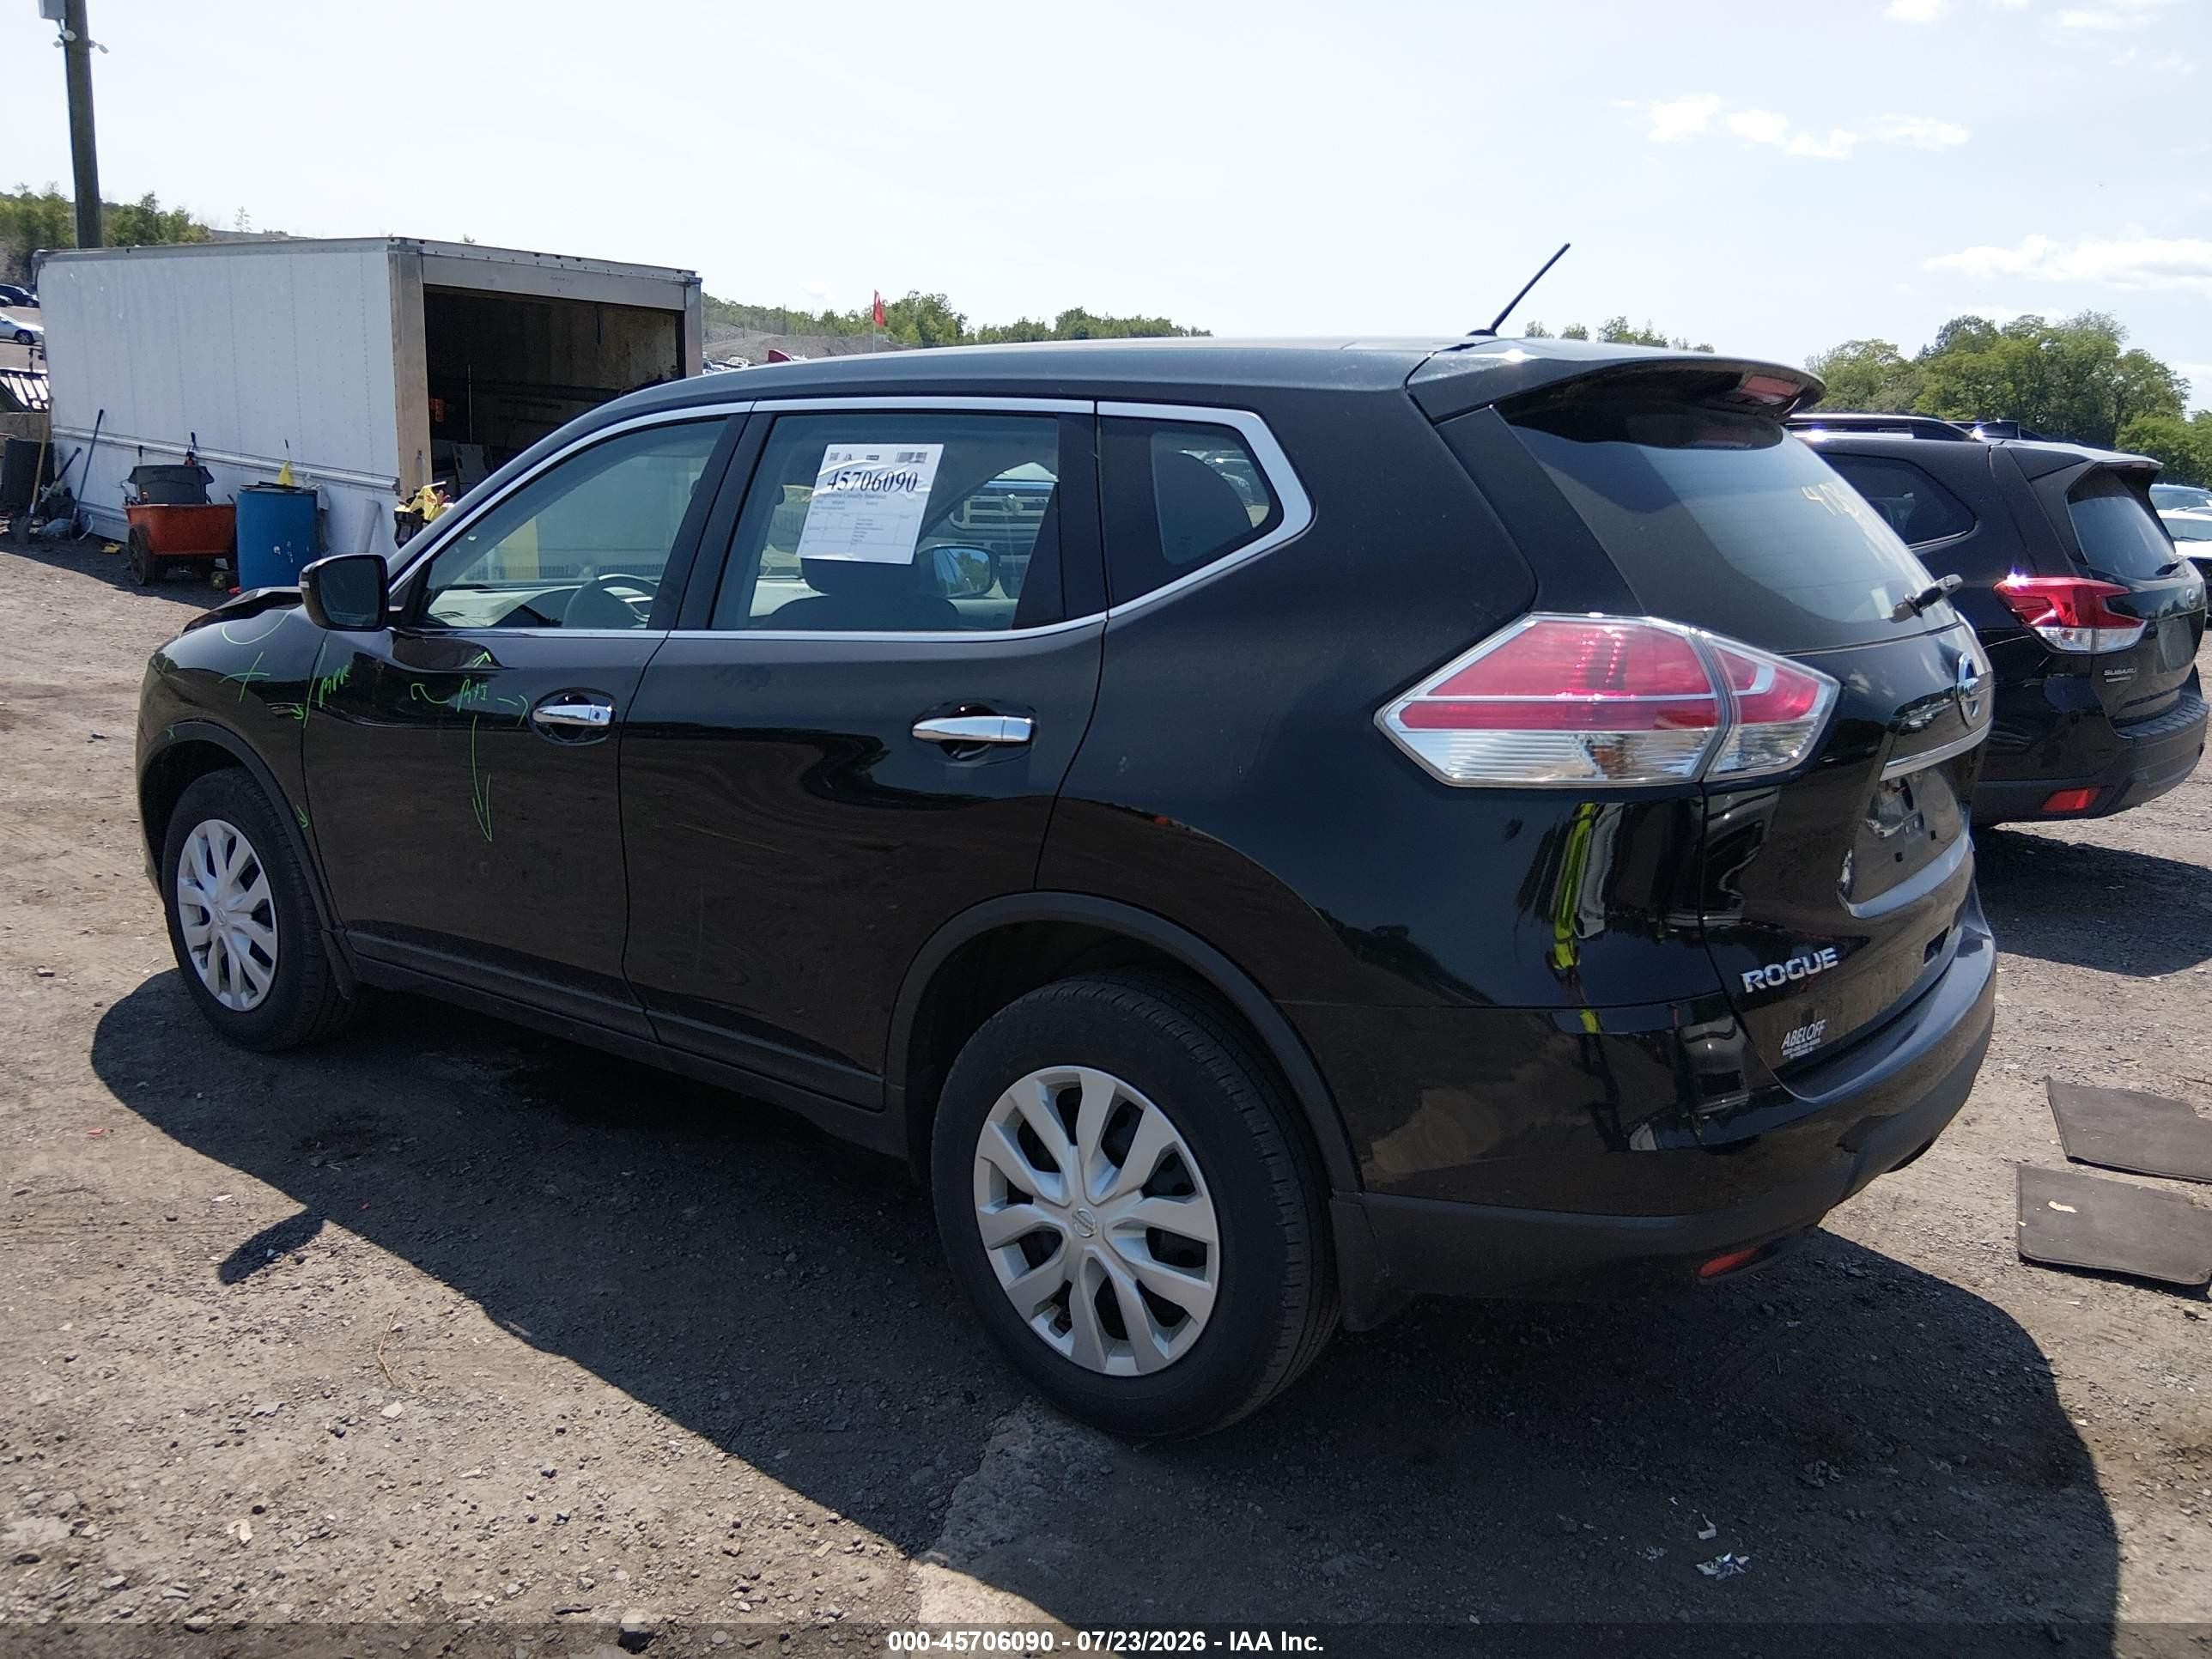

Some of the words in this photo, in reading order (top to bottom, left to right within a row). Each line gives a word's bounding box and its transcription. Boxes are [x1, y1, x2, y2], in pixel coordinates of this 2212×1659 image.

[826, 470, 918, 493] 45706090
[1741, 946, 1839, 994] ROGUE
[1780, 1019, 1826, 1050] ABELOFF
